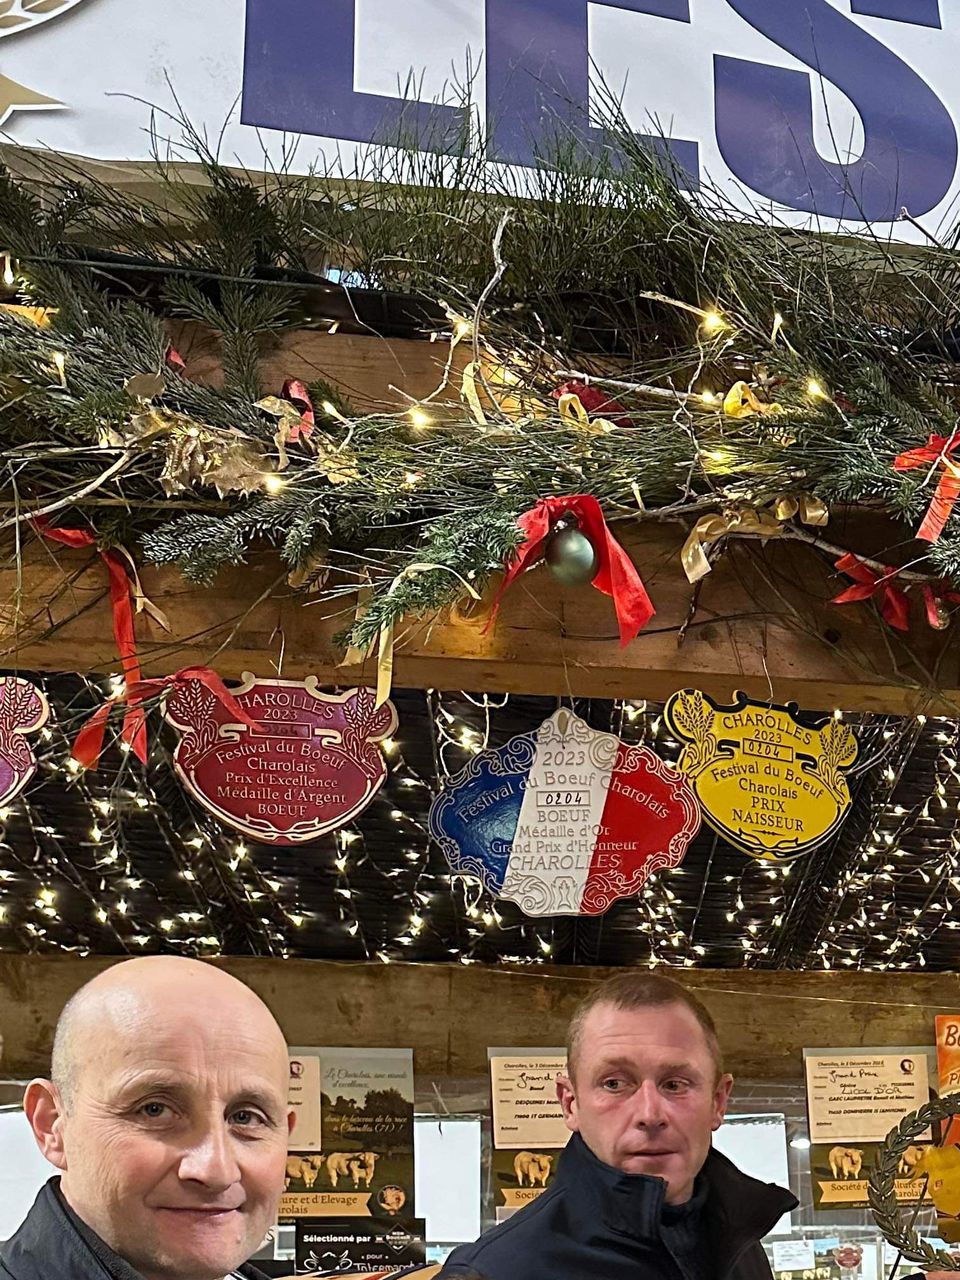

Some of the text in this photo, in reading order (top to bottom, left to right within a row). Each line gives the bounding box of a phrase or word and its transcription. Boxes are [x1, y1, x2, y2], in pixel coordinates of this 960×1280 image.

[237, 693, 335, 719] HAROLLES
[264, 708, 298, 719] 2023
[723, 714, 812, 745] CHAROLLES
[754, 729, 782, 743] 2023
[216, 741, 347, 769] Festival du Boeuf
[749, 742, 779, 758] 0204
[247, 757, 316, 773] Charolais
[542, 751, 586, 766] 2023
[226, 772, 338, 788] Prix d'Excellence
[711, 761, 824, 799] Festival du Boeuf
[739, 777, 798, 799] Charolais
[217, 786, 346, 806] Médaille d'Argent
[458, 771, 670, 823] Festival du Boeuf Charolais
[545, 794, 583, 805] 0204
[258, 803, 307, 816] BOEUF
[752, 796, 785, 813] PRIX
[537, 810, 591, 823] BOEUF
[732, 808, 804, 832] NAISSEUR
[519, 824, 610, 838] Médaille d'Or
[491, 839, 638, 854] Grand Prix d'Honneur
[509, 854, 622, 871] CHAROLLES
[831, 1182, 860, 1191] Société
[303, 1234, 354, 1243] Sélectionné
